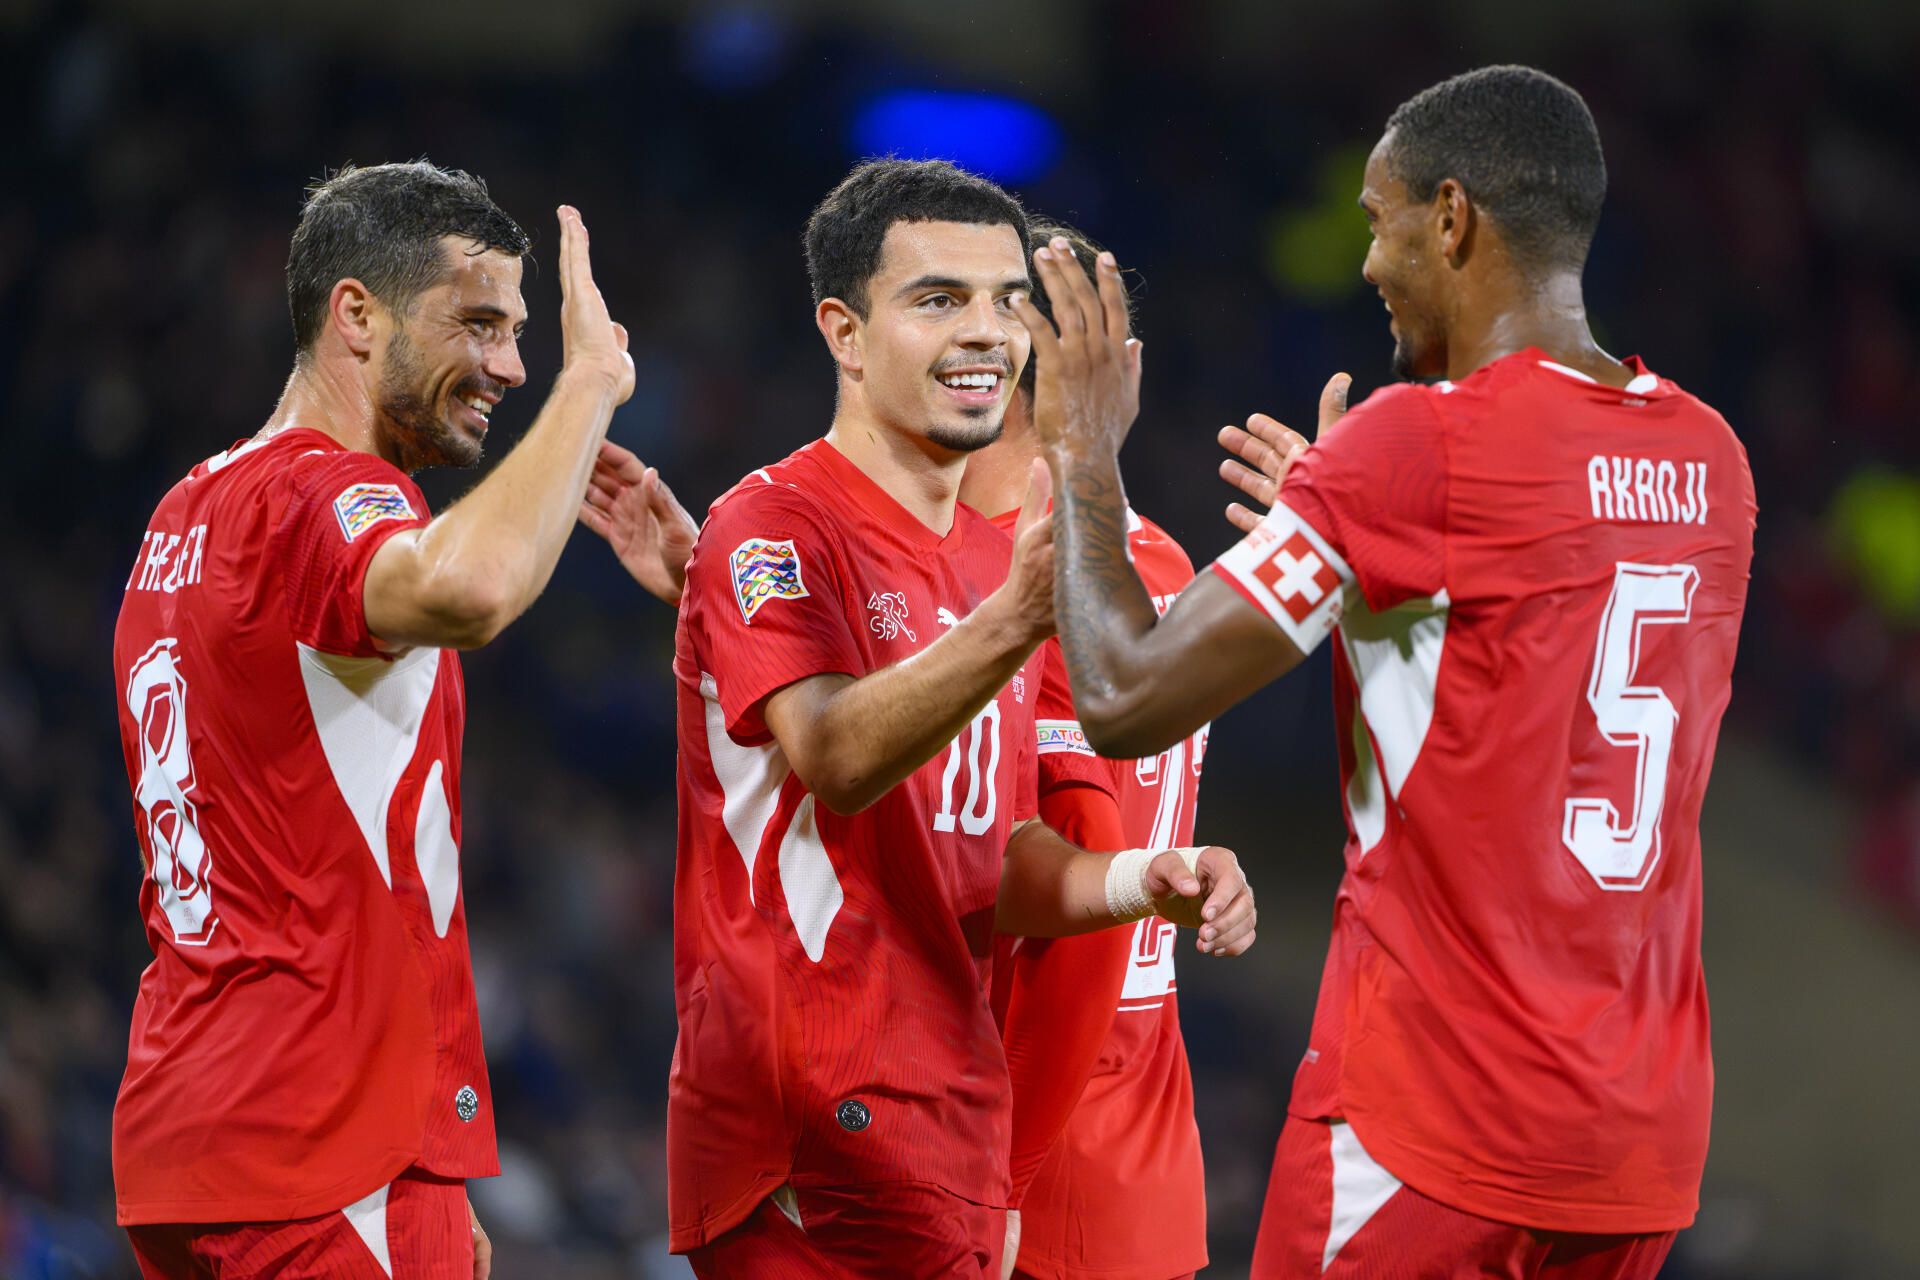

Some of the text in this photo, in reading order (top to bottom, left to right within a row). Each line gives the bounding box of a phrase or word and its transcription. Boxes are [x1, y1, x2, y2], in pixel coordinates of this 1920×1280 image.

[1587, 455, 1708, 525] AKANJI
[126, 637, 220, 945] 8
[932, 699, 1001, 836] 10
[1562, 562, 1701, 891] 5
